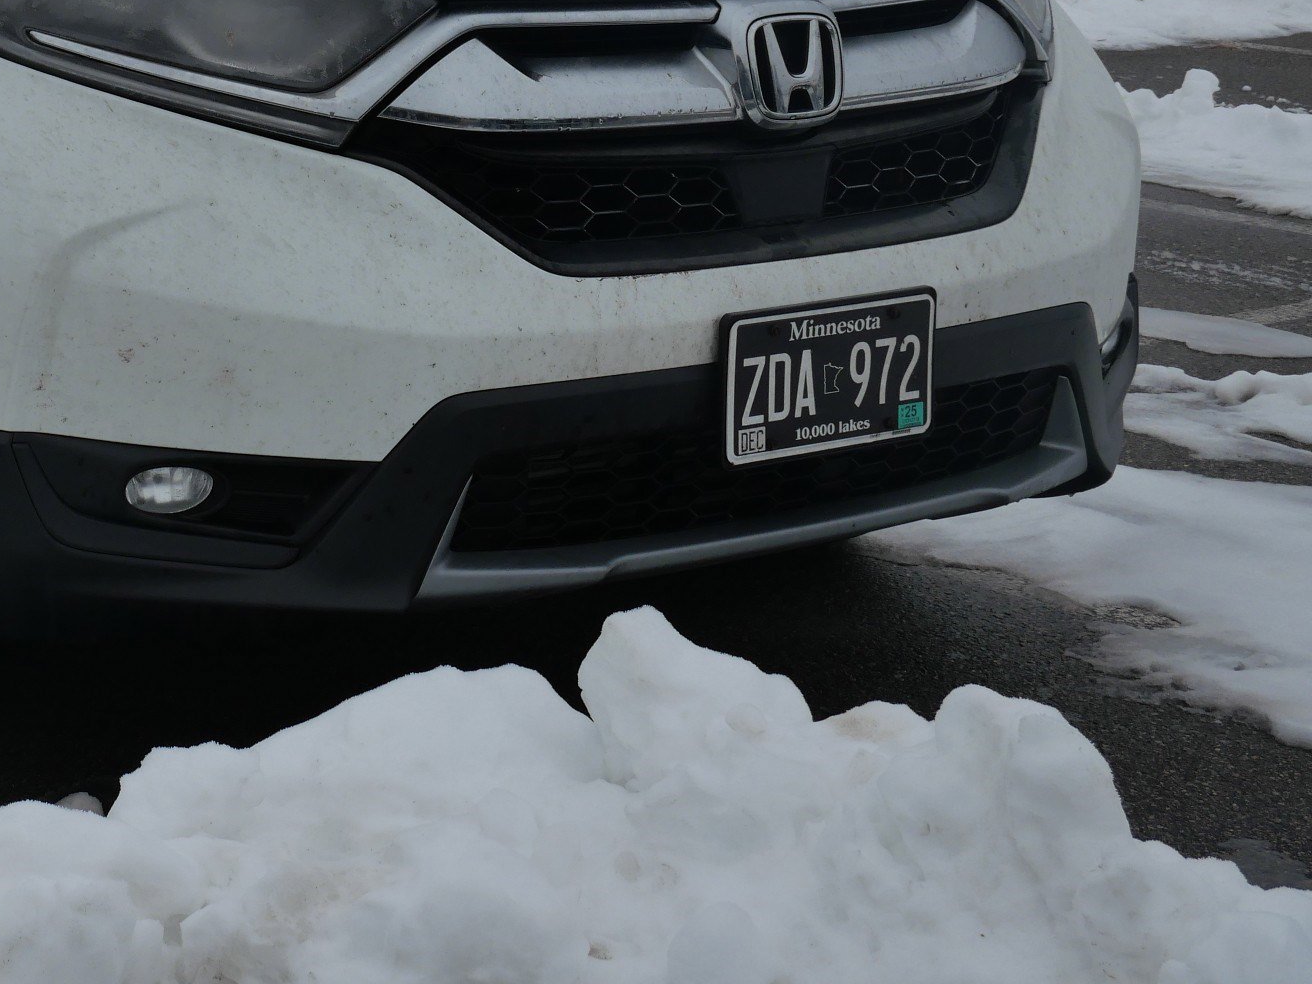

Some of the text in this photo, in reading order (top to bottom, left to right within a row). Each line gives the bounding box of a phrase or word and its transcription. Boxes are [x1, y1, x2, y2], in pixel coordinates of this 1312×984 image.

[789, 315, 881, 342] Minnesota
[741, 334, 921, 427] ZDA 972
[904, 405, 917, 418] 25
[741, 429, 765, 453] DEC
[795, 422, 835, 441] 10,000
[838, 419, 871, 434] lakes
